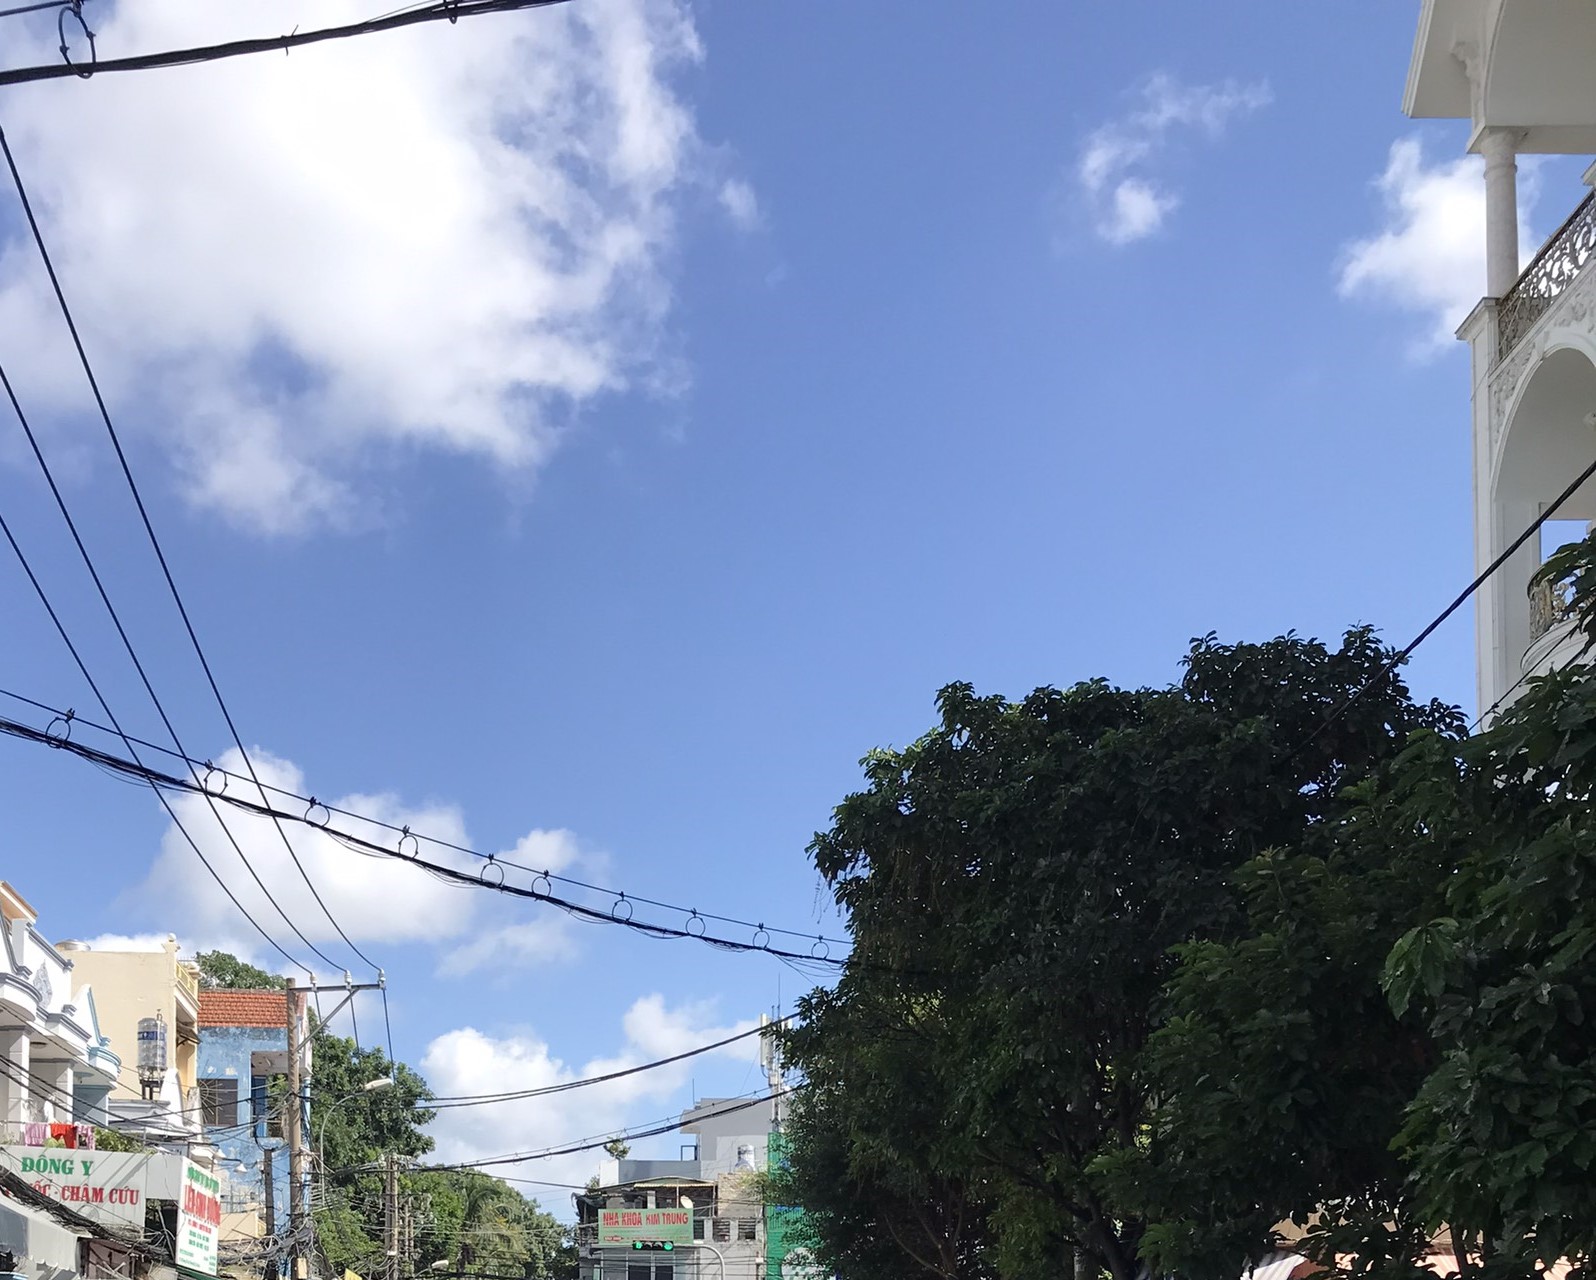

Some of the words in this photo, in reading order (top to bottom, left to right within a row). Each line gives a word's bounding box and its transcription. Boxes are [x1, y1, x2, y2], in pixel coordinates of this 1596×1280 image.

[21, 1154, 75, 1175] ĐÔNG
[81, 1160, 94, 1176] Y
[61, 1183, 104, 1203] CHÂM
[109, 1185, 140, 1205] CỨU
[603, 1212, 619, 1226] NHA
[621, 1212, 642, 1226] KHOA
[662, 1212, 689, 1225] TRUNG
